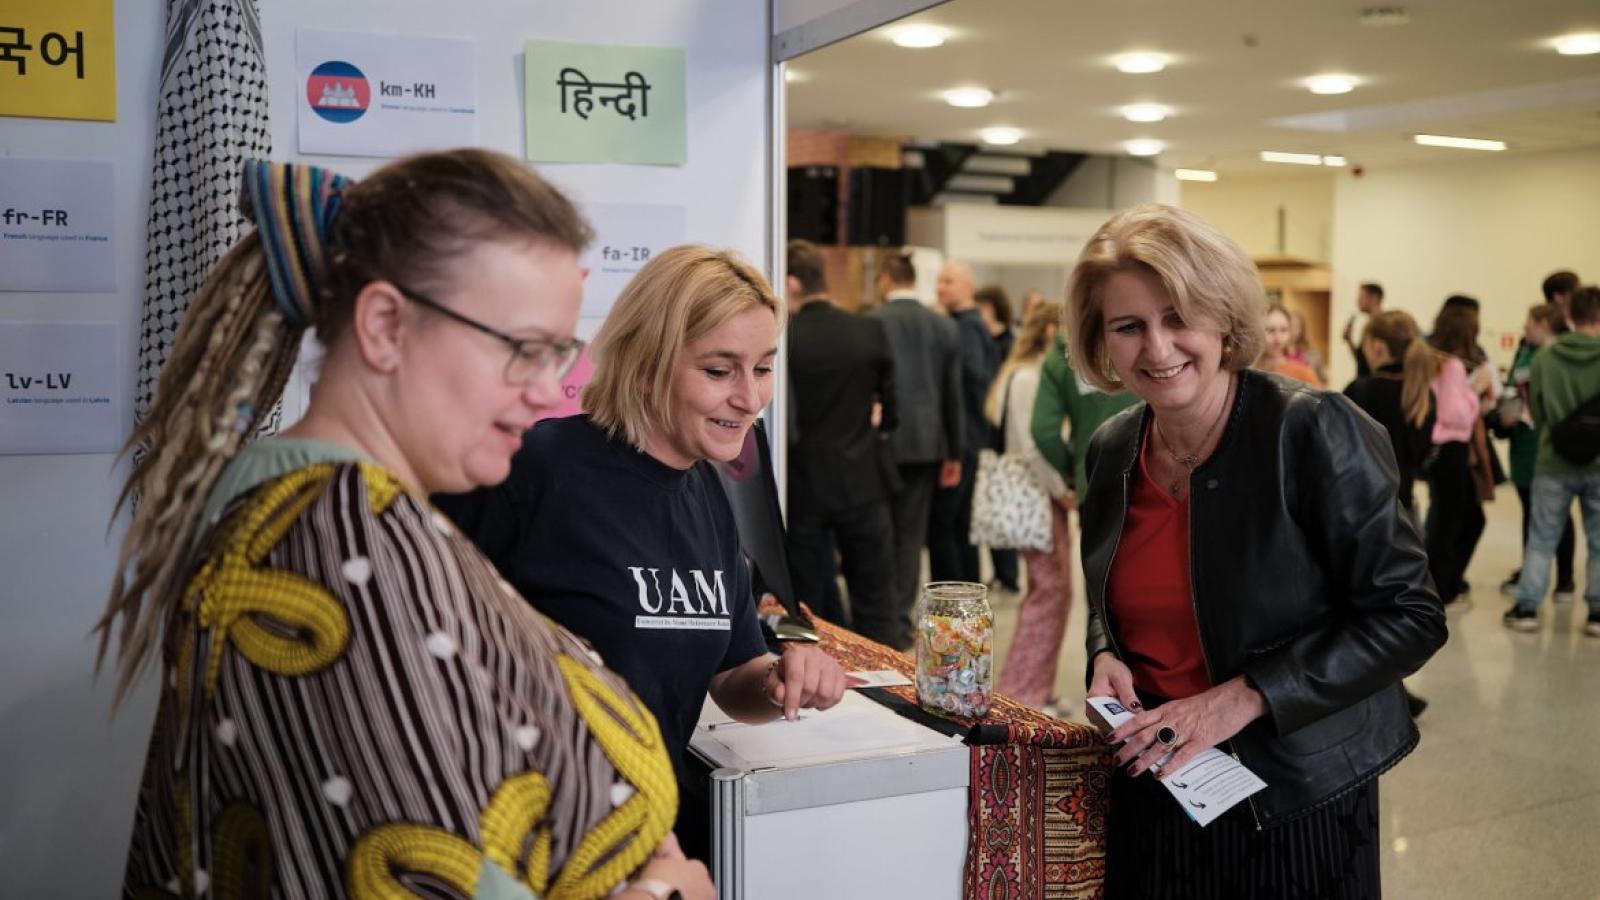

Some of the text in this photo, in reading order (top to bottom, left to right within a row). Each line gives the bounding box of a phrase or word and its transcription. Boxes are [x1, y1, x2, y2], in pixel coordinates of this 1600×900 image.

[380, 80, 435, 98] km-KH
[556, 67, 651, 120] हिन्दी
[2, 208, 68, 226] fr-FR
[602, 246, 650, 261] fa-IR
[5, 373, 71, 389] lv-LV
[627, 566, 730, 615] UAM
